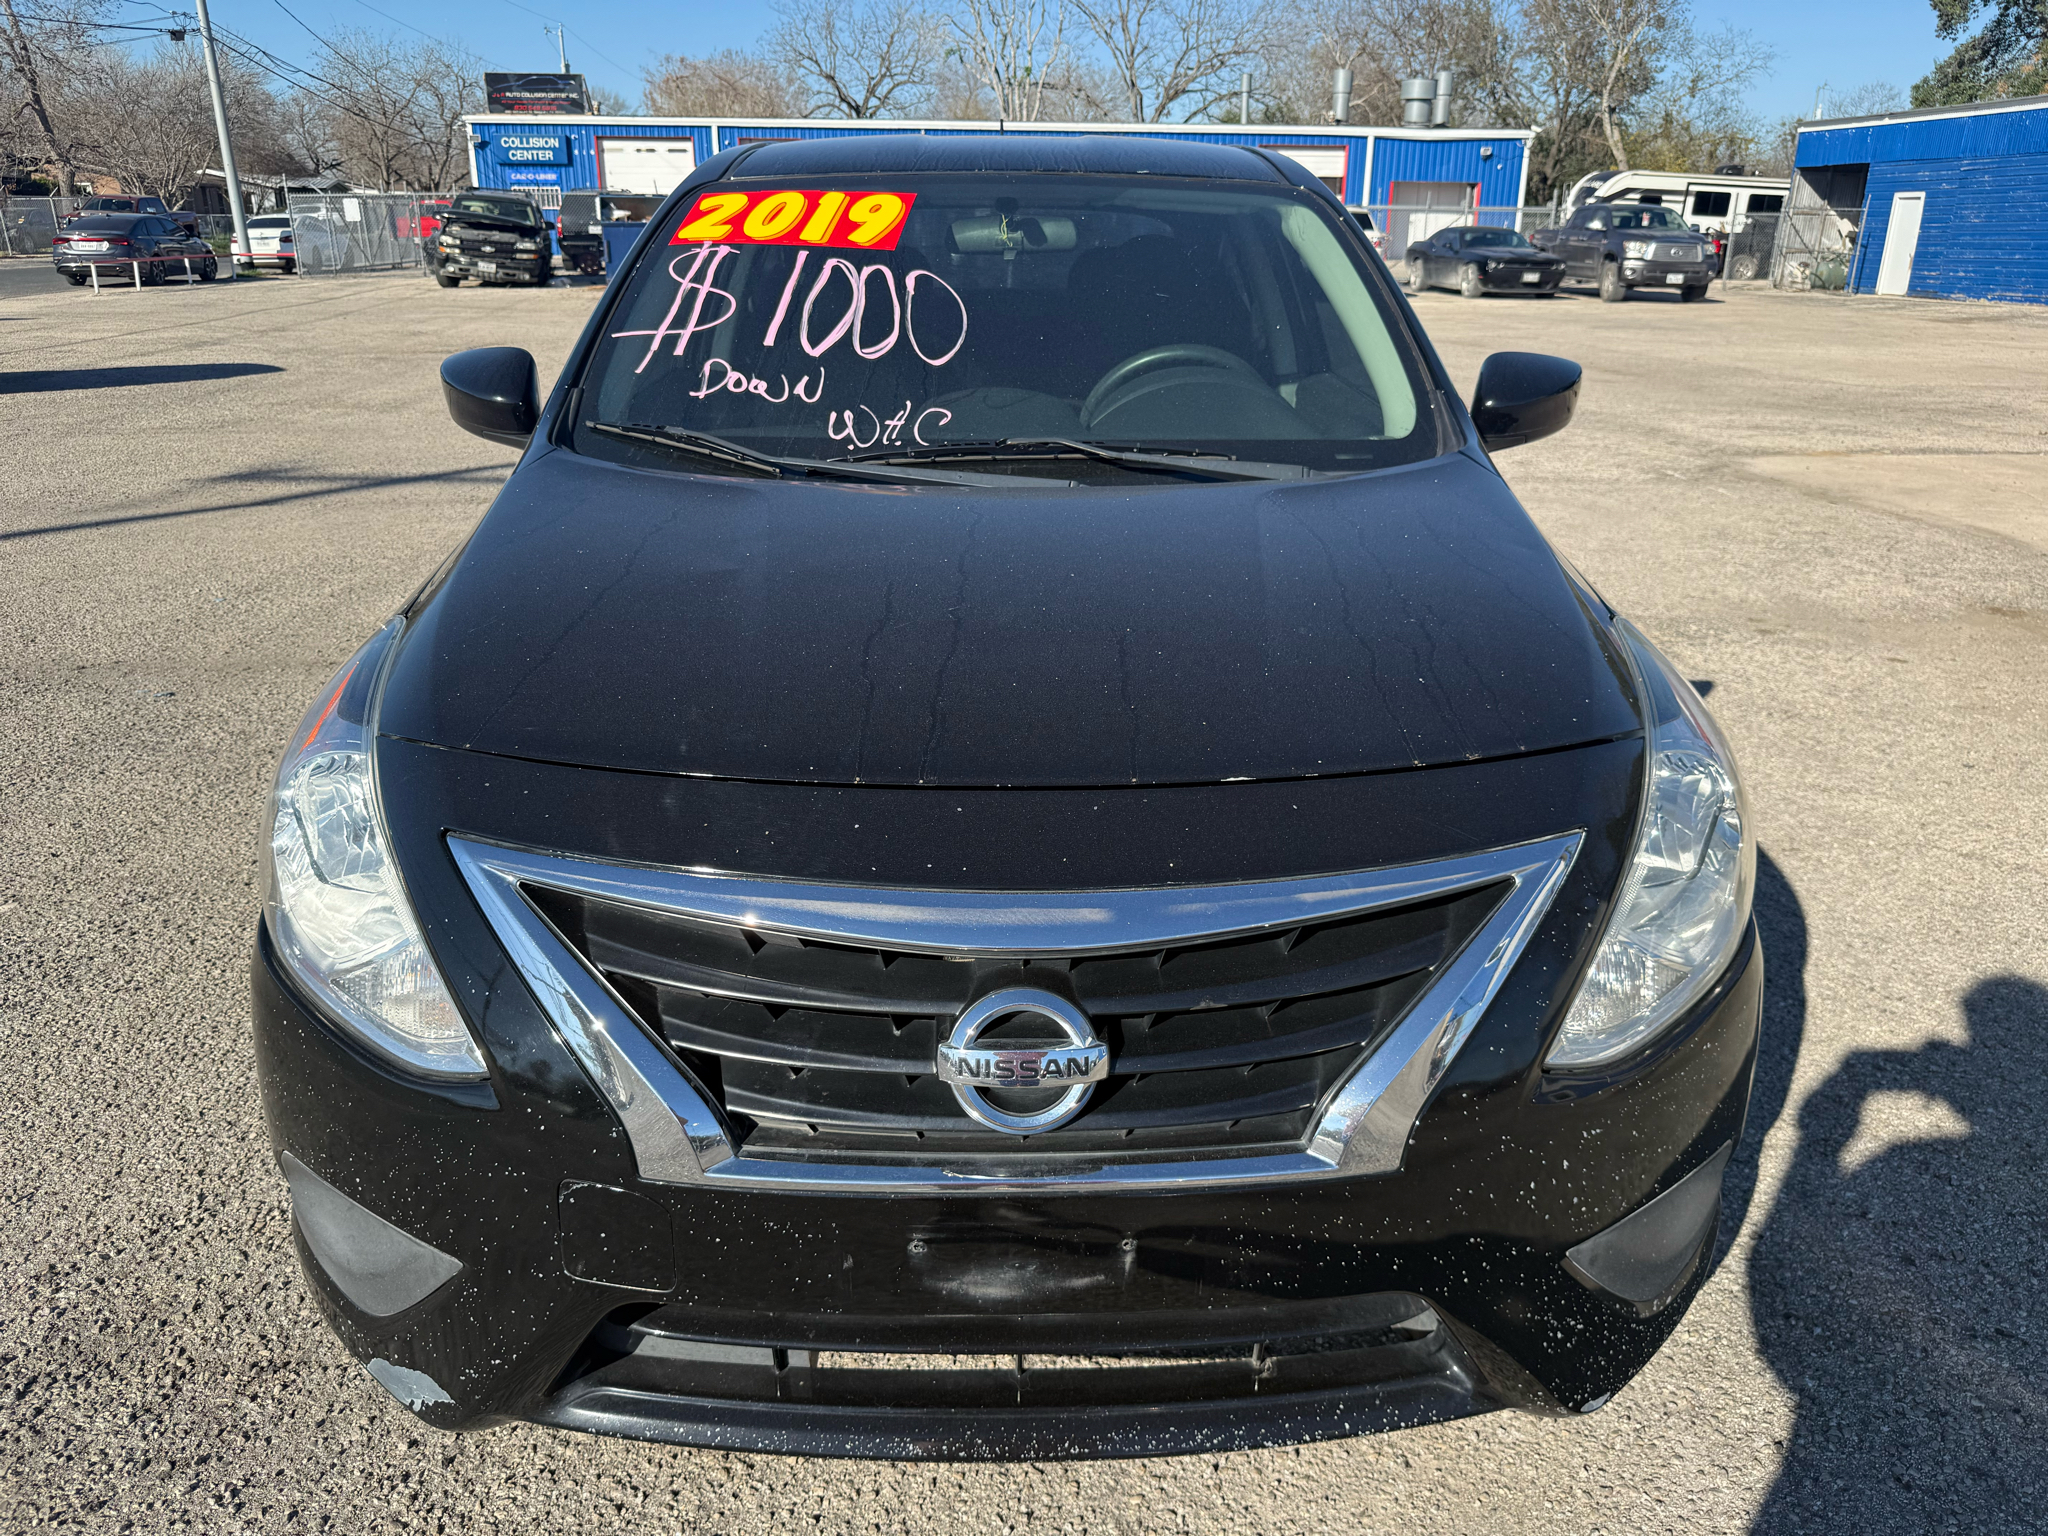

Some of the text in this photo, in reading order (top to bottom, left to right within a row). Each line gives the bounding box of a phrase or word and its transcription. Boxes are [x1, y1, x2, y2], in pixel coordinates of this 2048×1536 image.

[501, 137, 559, 149] COLLISION
[509, 151, 553, 161] CENTER
[678, 191, 905, 244] 2019
[957, 1056, 1090, 1080] NISSAN
